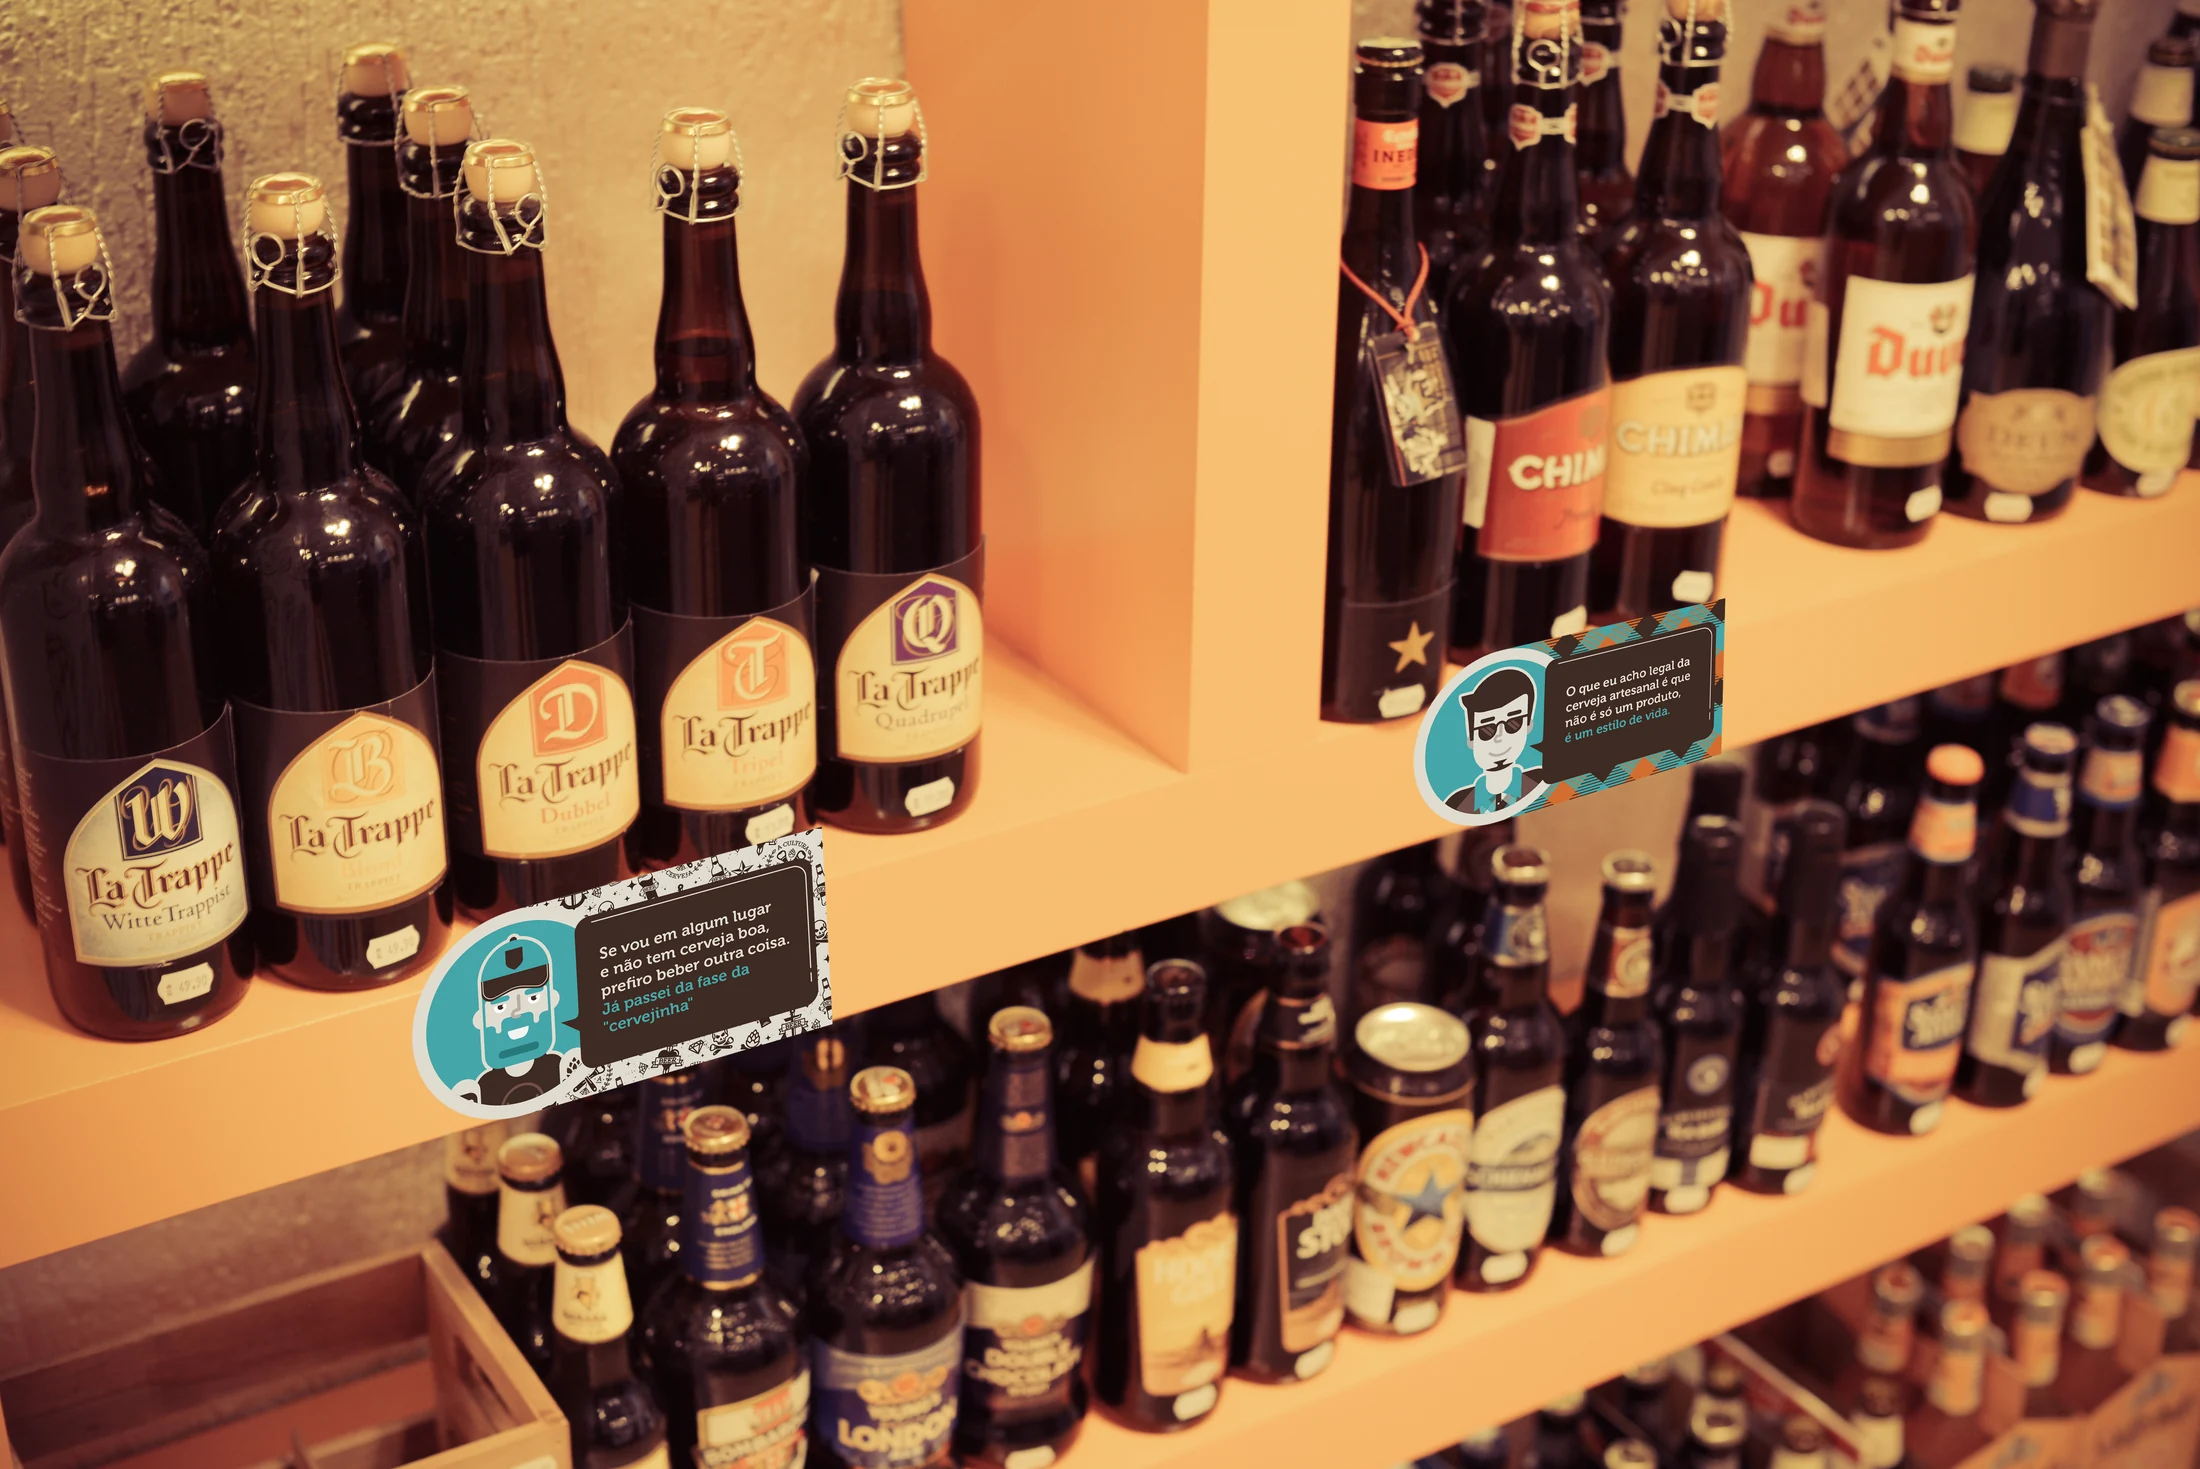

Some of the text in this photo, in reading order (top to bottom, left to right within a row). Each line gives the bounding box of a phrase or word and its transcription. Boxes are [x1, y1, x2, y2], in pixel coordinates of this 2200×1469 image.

[847, 656, 981, 709] La Trappe
[1565, 672, 1691, 713] cerveja artesanal é que
[1566, 657, 1691, 697] O que eu acho legal da
[673, 700, 811, 757] La Trappe
[875, 698, 970, 732] Quadrupel
[1564, 690, 1682, 728] não é só um produto,
[1564, 707, 1671, 743] é um estilo de vida.
[488, 741, 633, 804] La Trappe
[730, 750, 785, 776] Tripel
[279, 796, 435, 860] La Trappe
[540, 791, 611, 825] Dubbel
[783, 840, 809, 852] CULTURA
[74, 840, 235, 918] La Trappe
[665, 870, 694, 880] CERVEJA
[102, 884, 232, 931] Witte Trappist
[599, 903, 772, 960] Se vou em algum lugar
[600, 923, 770, 978] e não tem cerveja boa,
[601, 936, 790, 1000] prefiro beber outra coisa.
[602, 964, 750, 1016] Já passei da fase da
[603, 997, 693, 1032] "cervejinha"
[659, 1056, 677, 1065] BEER
